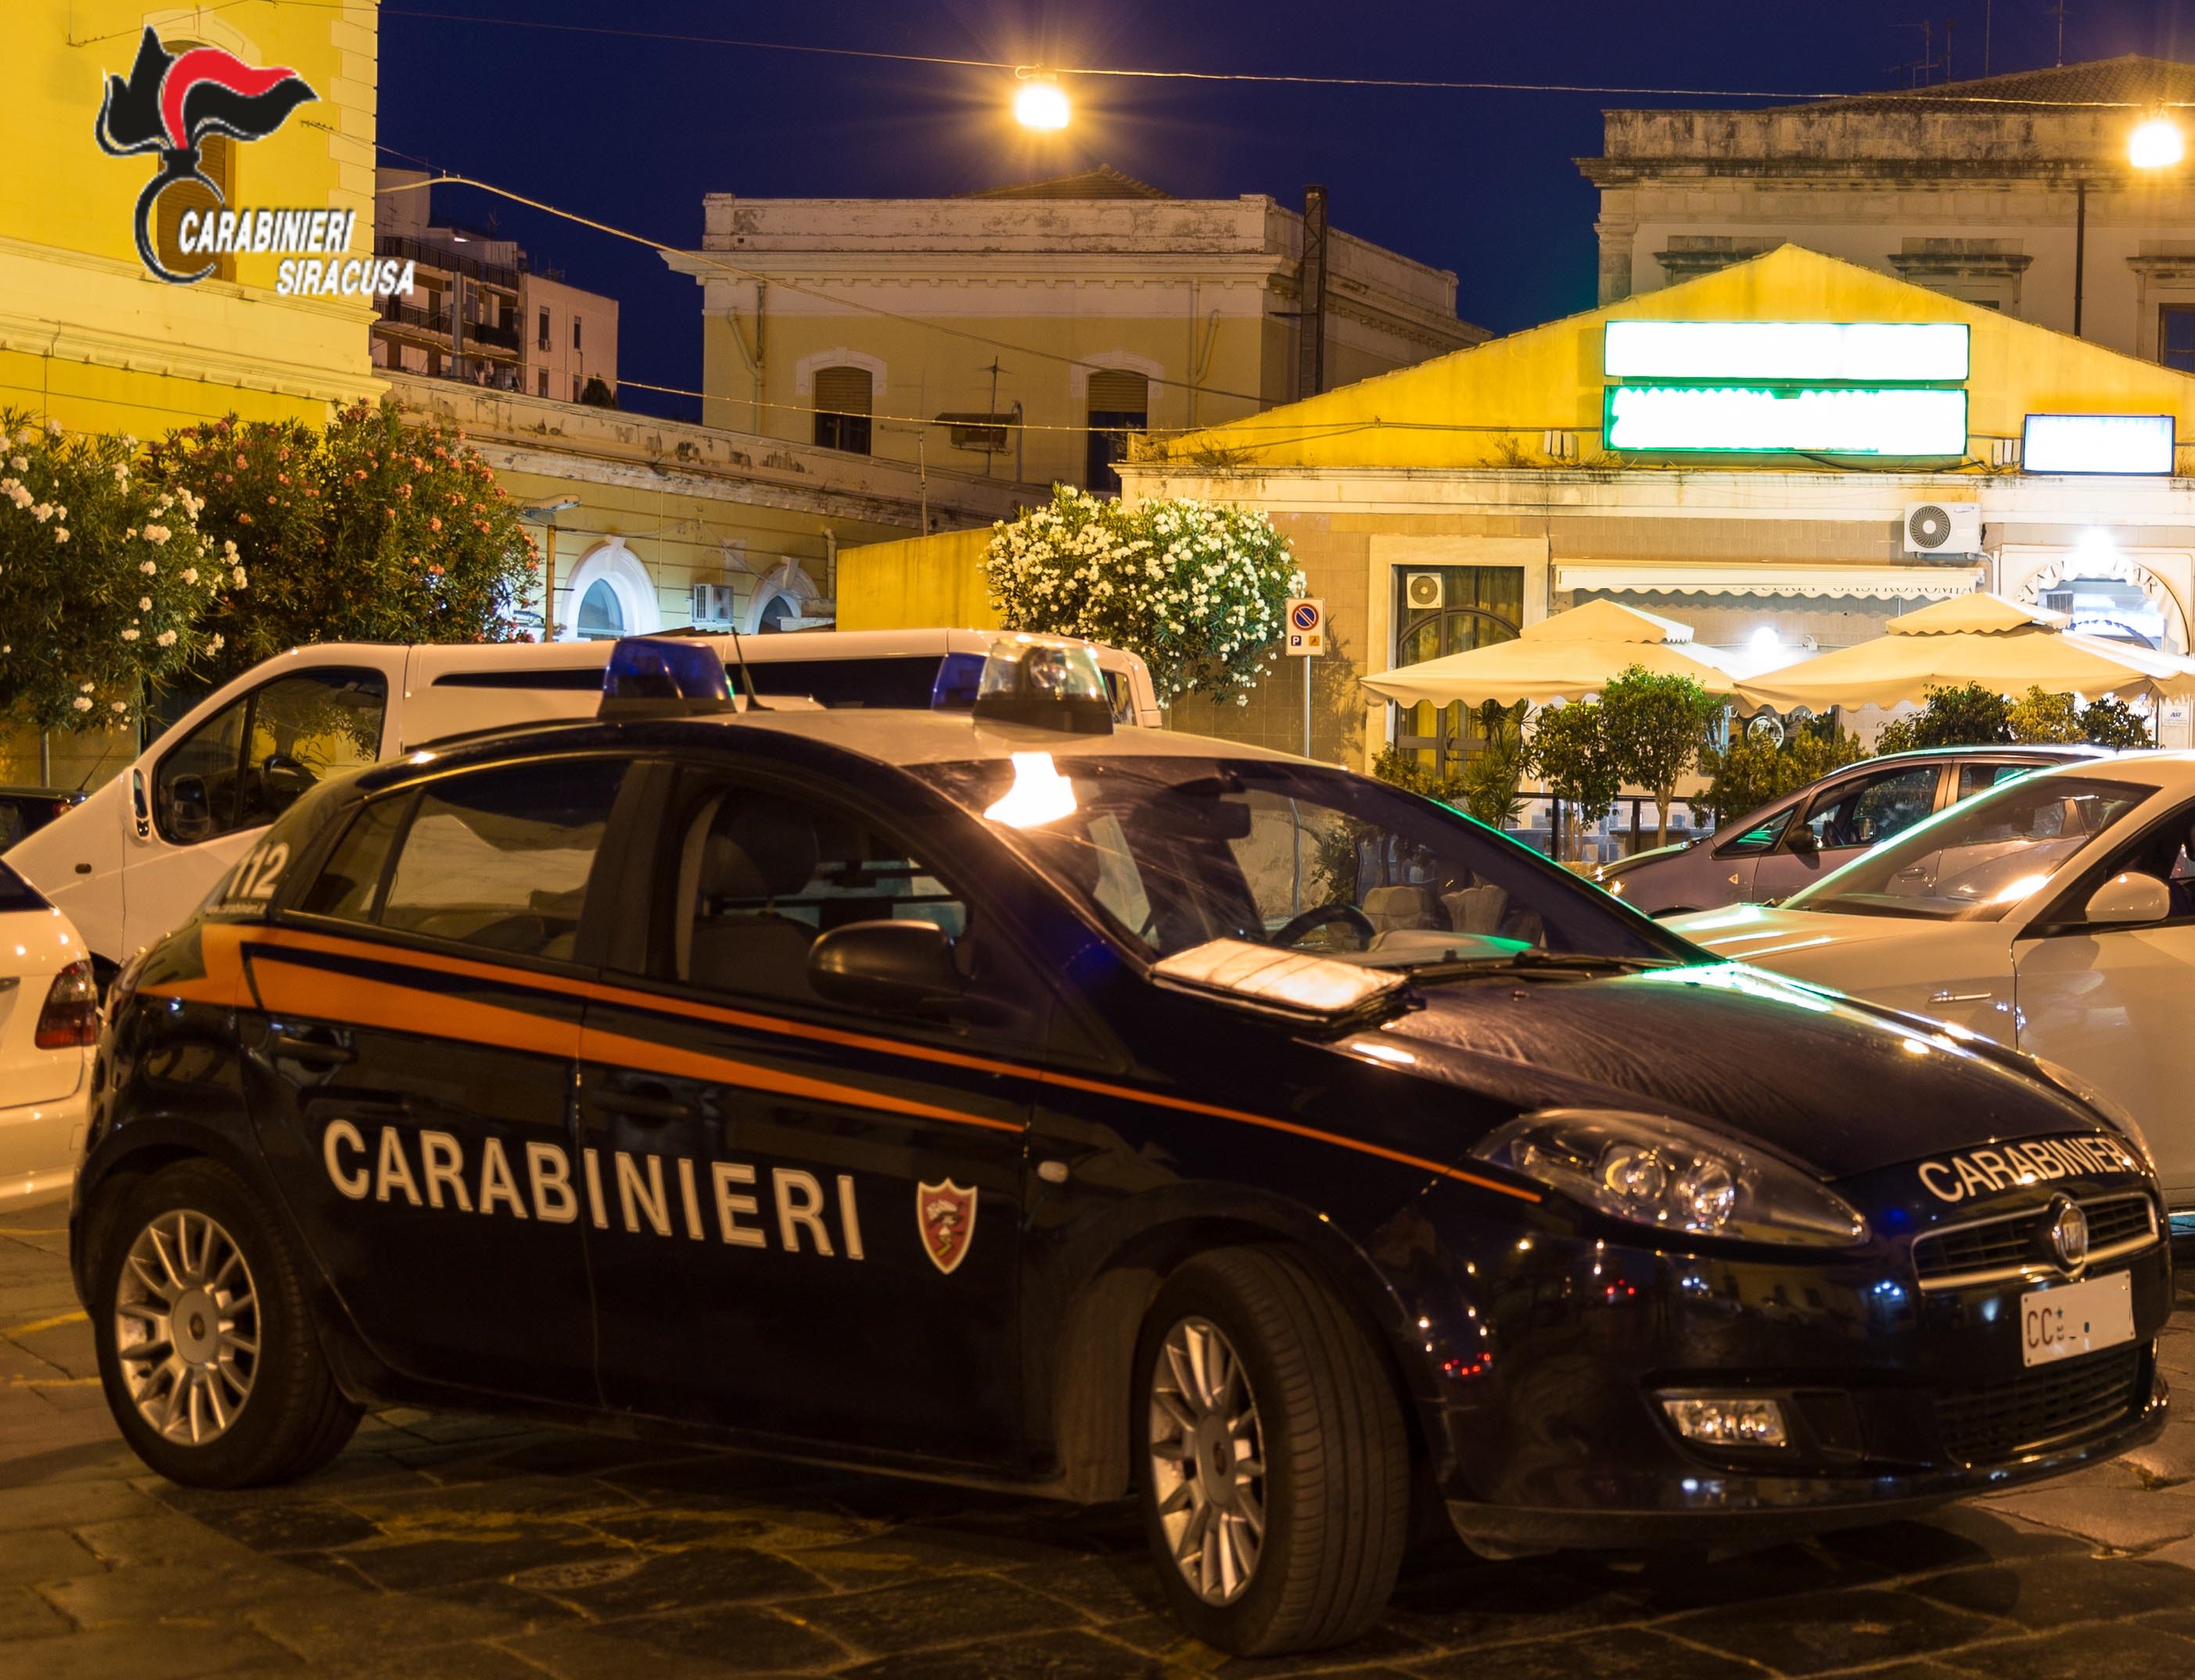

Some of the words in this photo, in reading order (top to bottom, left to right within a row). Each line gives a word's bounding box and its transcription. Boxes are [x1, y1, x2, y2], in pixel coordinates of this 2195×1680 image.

[226, 842, 289, 898] 112
[323, 1118, 864, 1261] CARABINIERI
[1918, 1136, 2140, 1202] CARABINIERI
